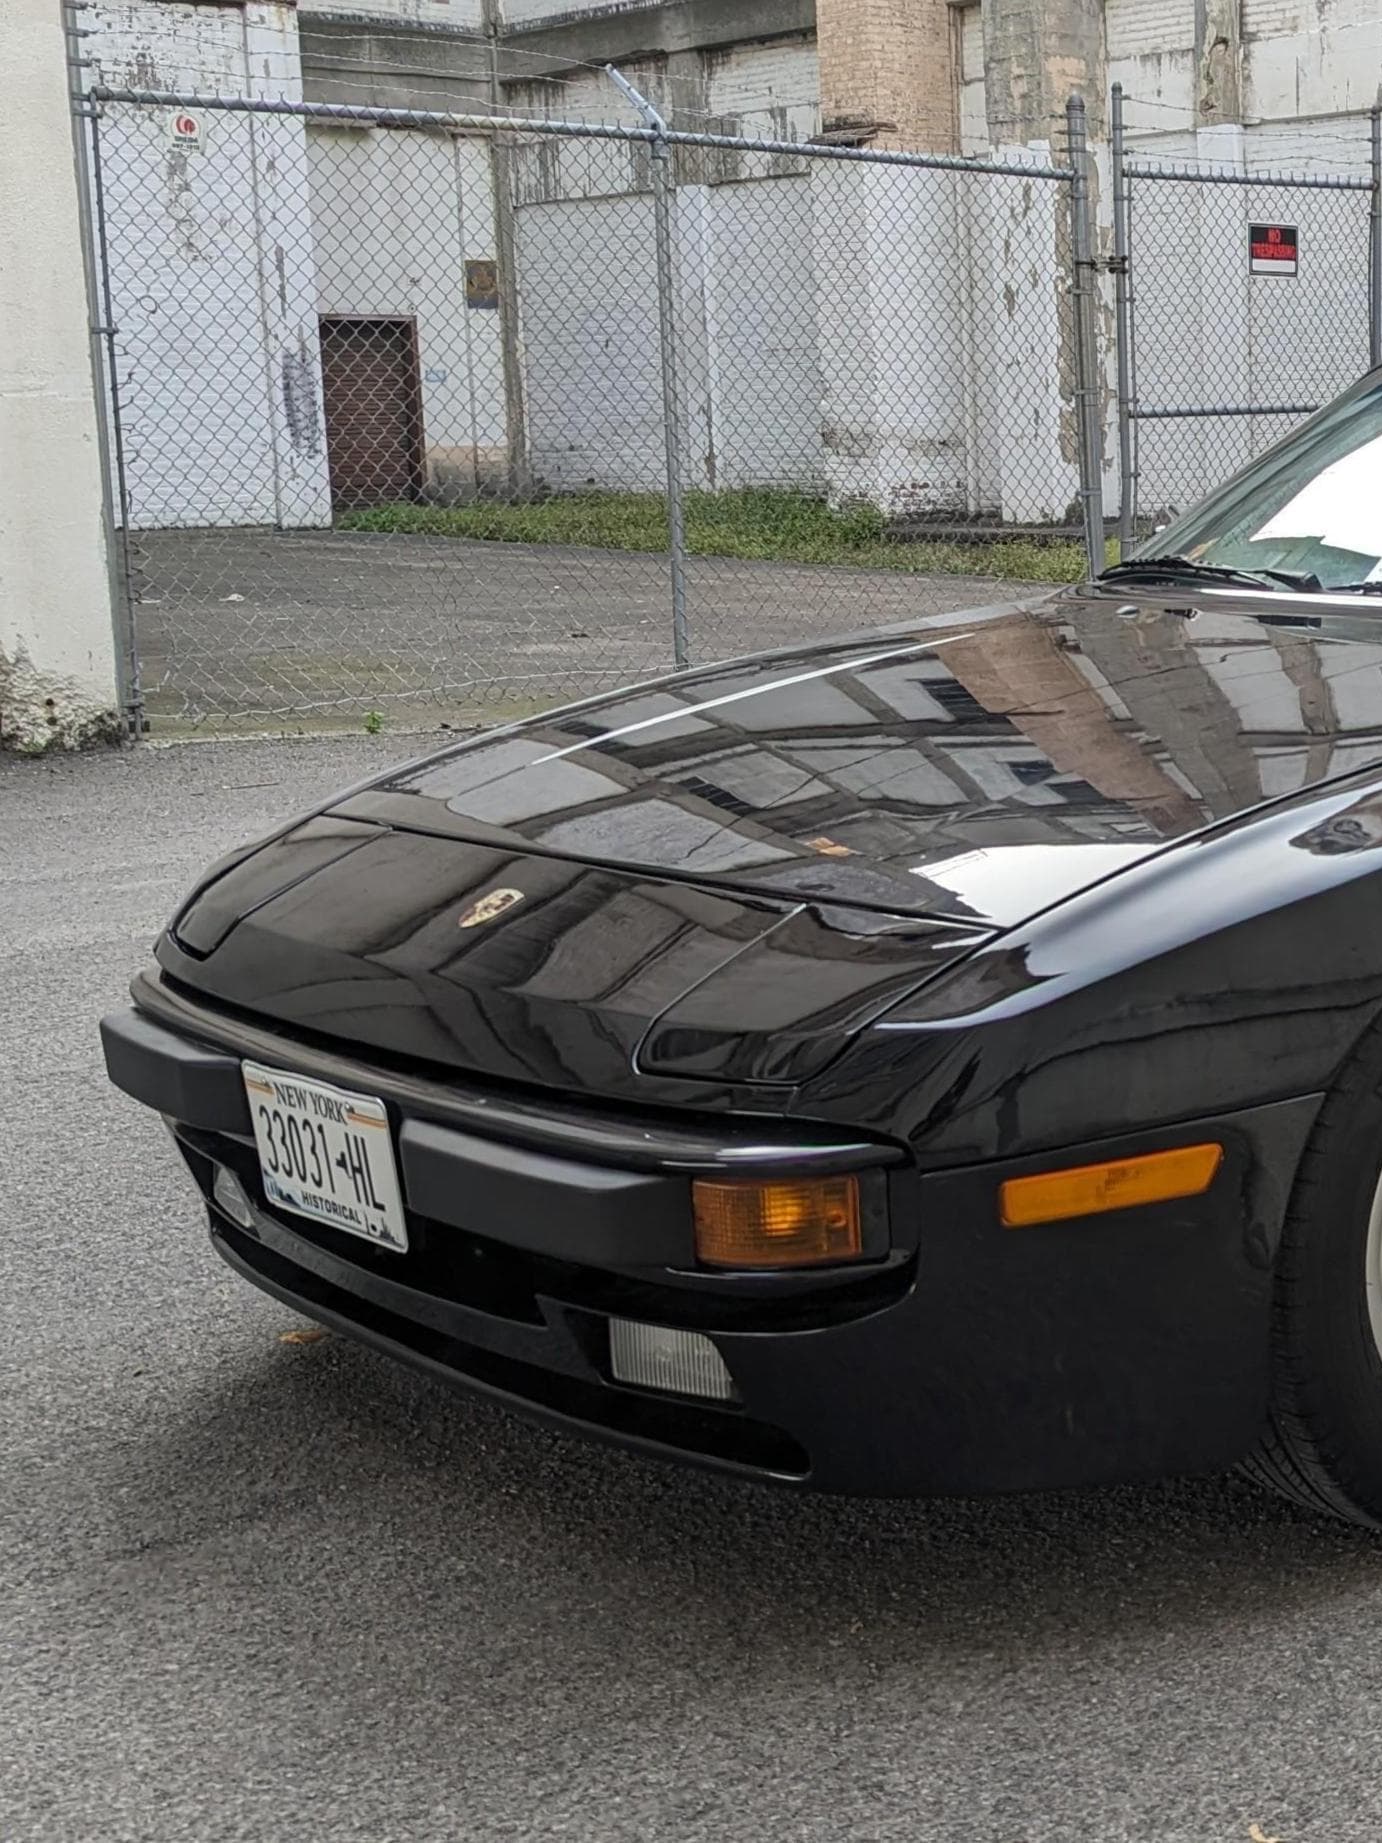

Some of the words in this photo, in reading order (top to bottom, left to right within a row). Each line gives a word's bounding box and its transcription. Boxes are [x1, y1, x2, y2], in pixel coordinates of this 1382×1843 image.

[1268, 228, 1281, 243] NO
[273, 1082, 309, 1111] NEW
[309, 1090, 349, 1126] YORK
[301, 1190, 363, 1225] HISTORICAL
